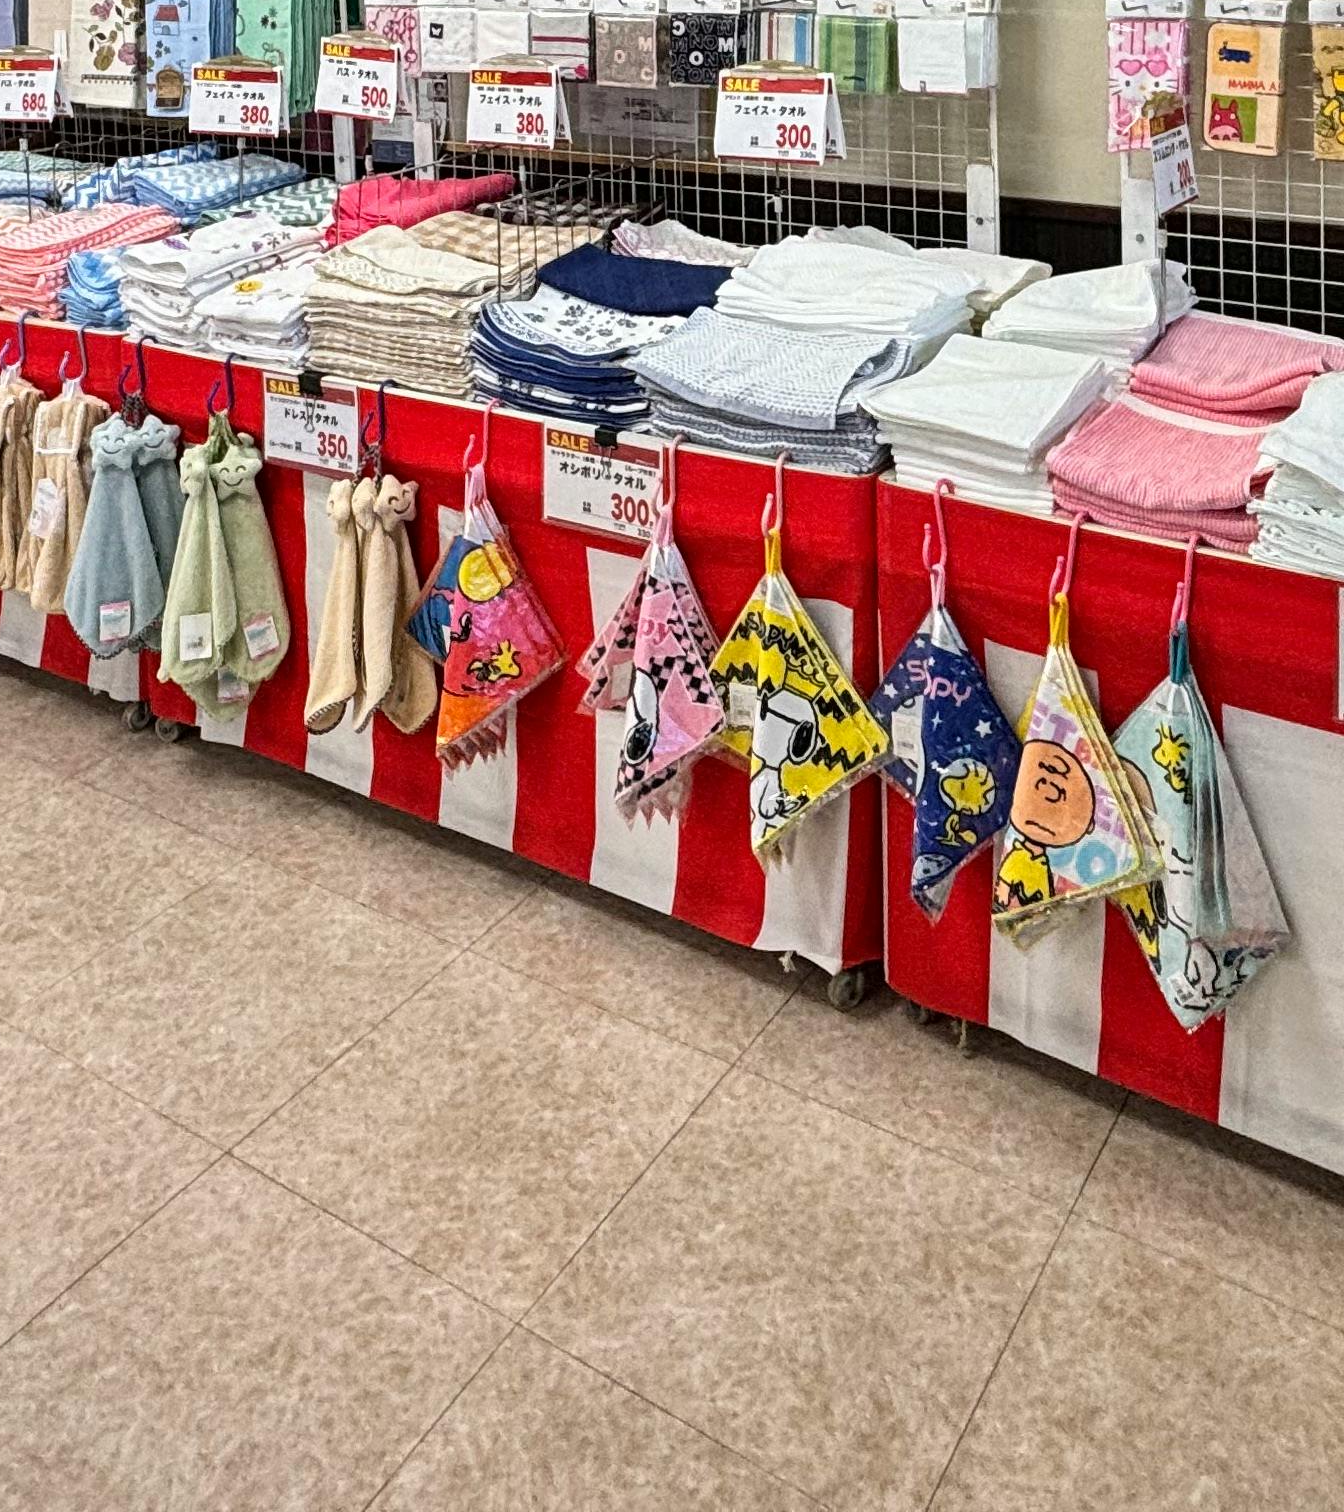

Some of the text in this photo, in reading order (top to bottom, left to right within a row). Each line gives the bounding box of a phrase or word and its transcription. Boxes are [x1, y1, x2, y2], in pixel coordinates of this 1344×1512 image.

[325, 43, 351, 57] SALE
[196, 68, 226, 80] SALE
[337, 67, 379, 80] バス・タオル
[473, 71, 503, 84] SALE
[724, 77, 760, 92] SALE
[205, 90, 266, 101] フェイス・タオル
[479, 94, 543, 107] フェイス・タオル
[734, 104, 807, 117] フェイス・タオル
[269, 379, 301, 396] SALE
[551, 431, 590, 452] SALE
